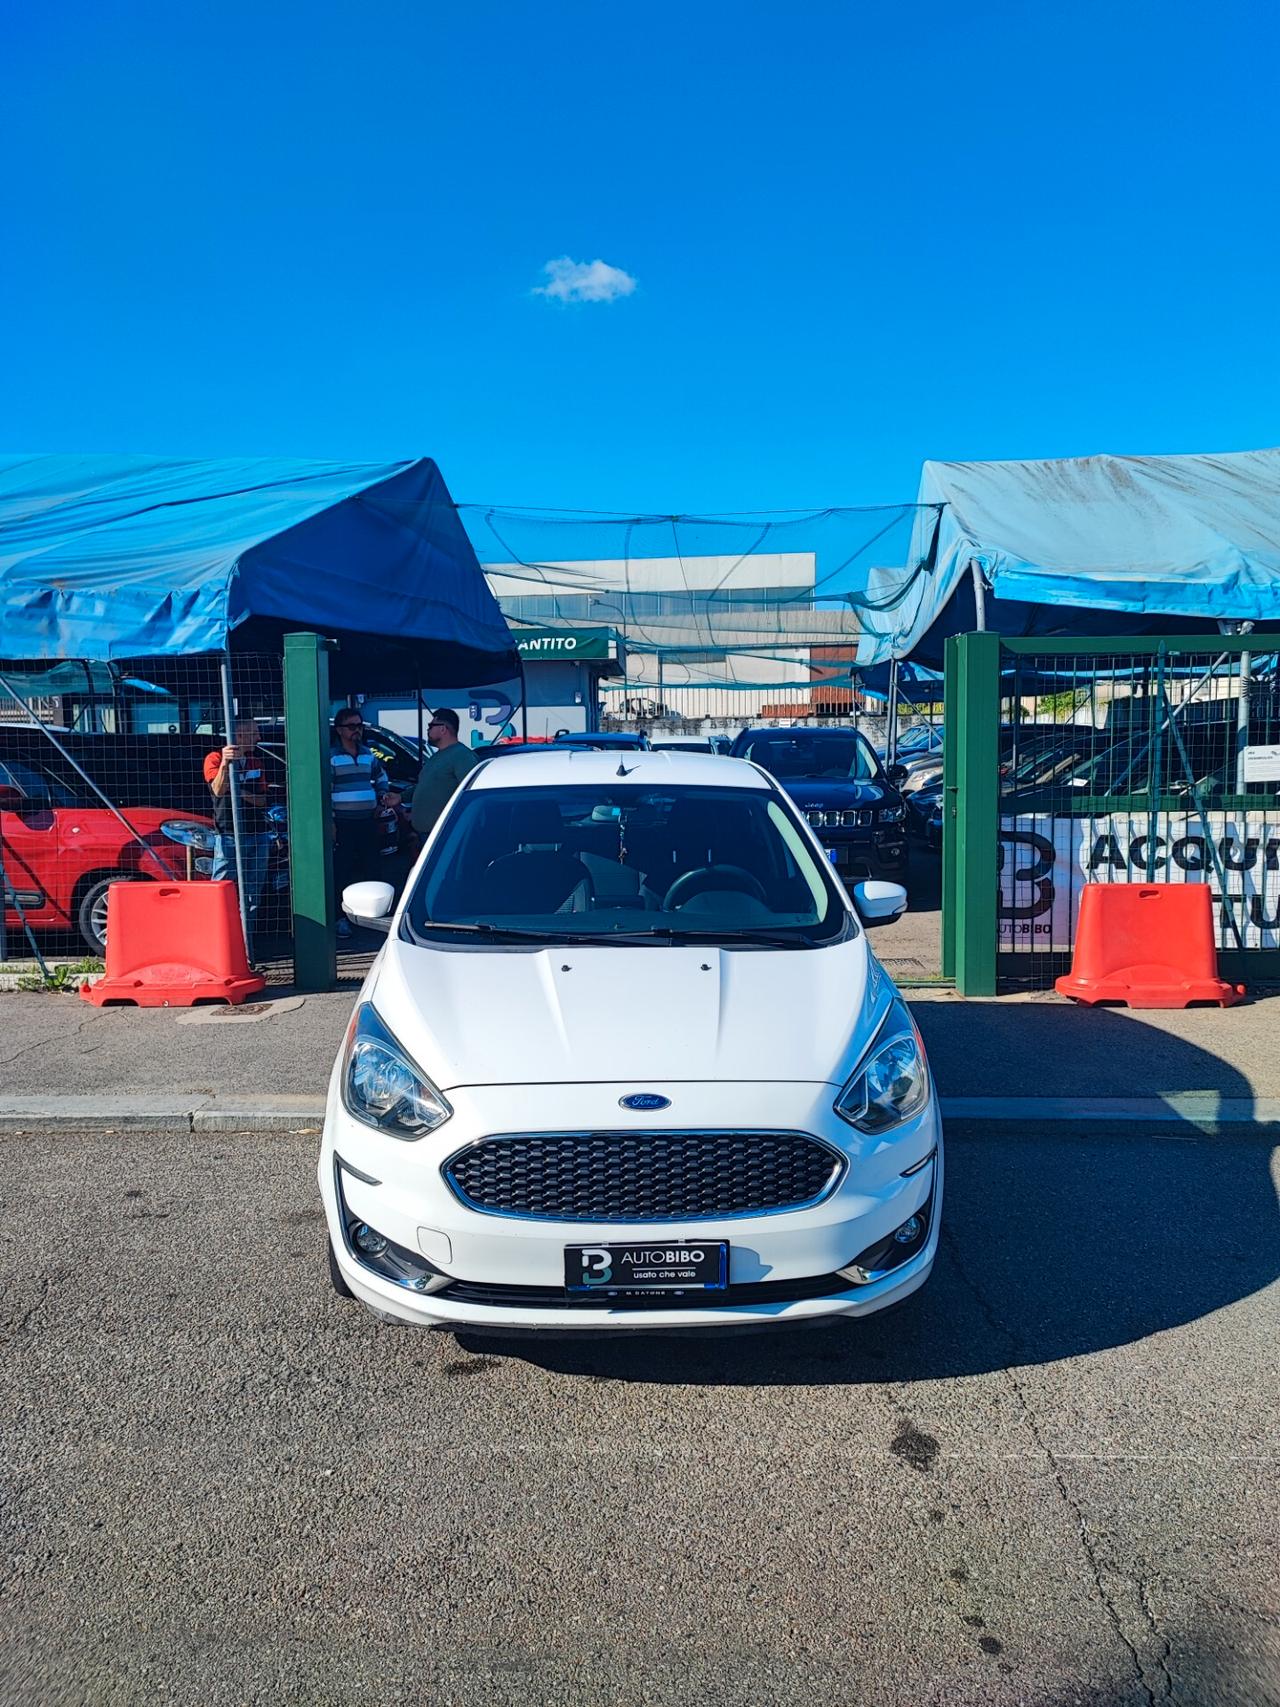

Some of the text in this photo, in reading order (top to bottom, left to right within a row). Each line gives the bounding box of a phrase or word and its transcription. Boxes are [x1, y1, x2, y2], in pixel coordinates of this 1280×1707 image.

[514, 637, 577, 650] ANTITO
[632, 1096, 660, 1106] Ford
[620, 1250, 705, 1264] AUTOBIBO
[633, 1269, 696, 1279] usato che vale
